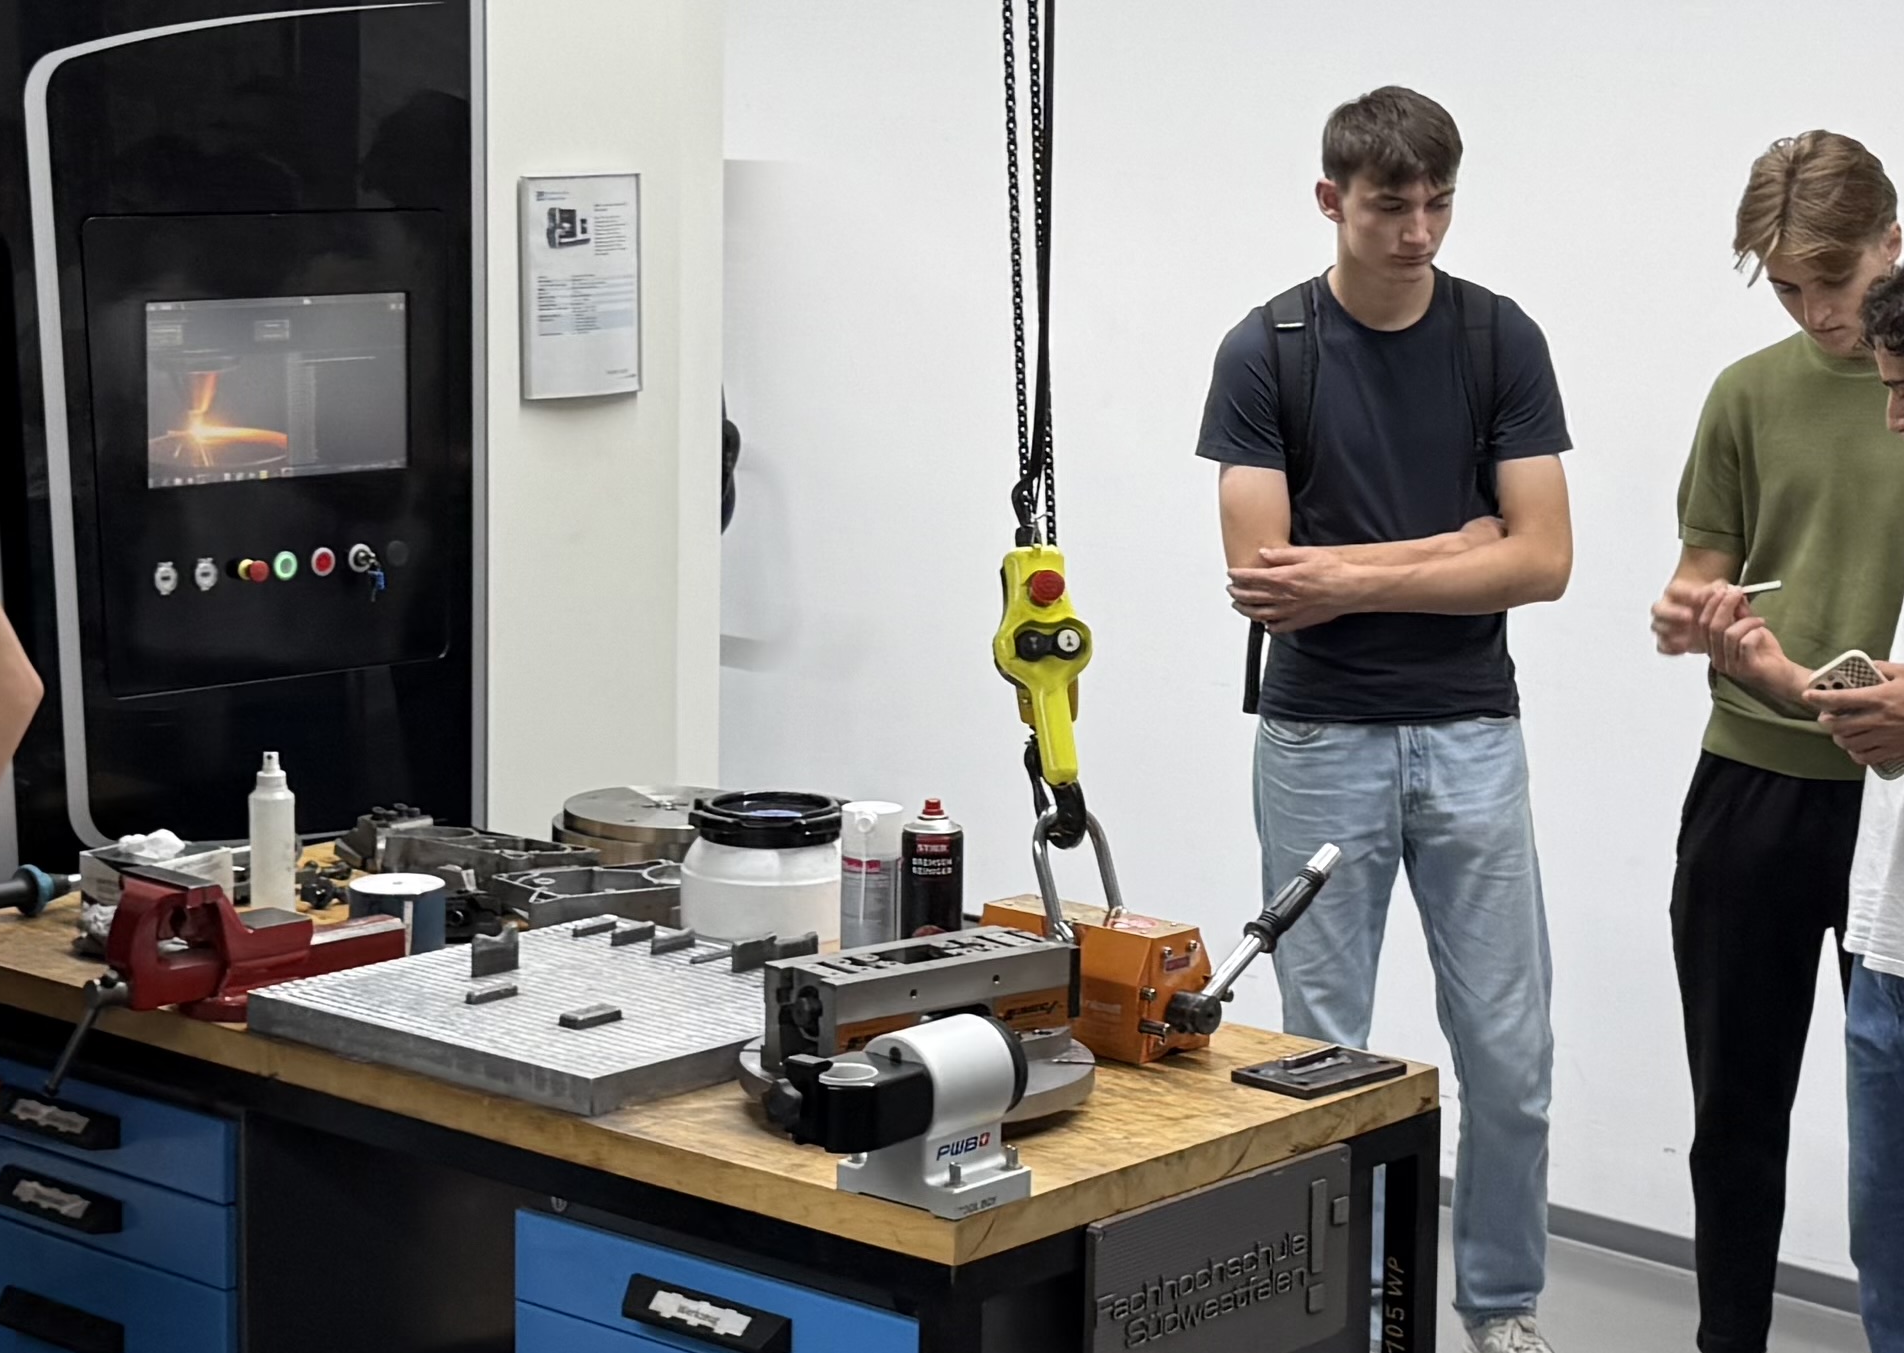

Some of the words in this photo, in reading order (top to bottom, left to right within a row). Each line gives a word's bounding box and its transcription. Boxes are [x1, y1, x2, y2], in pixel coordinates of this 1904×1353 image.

[937, 1136, 978, 1161] PWB
[1097, 1232, 1308, 1321] Fachhochschule
[1125, 1267, 1307, 1349] Südwestfalen
